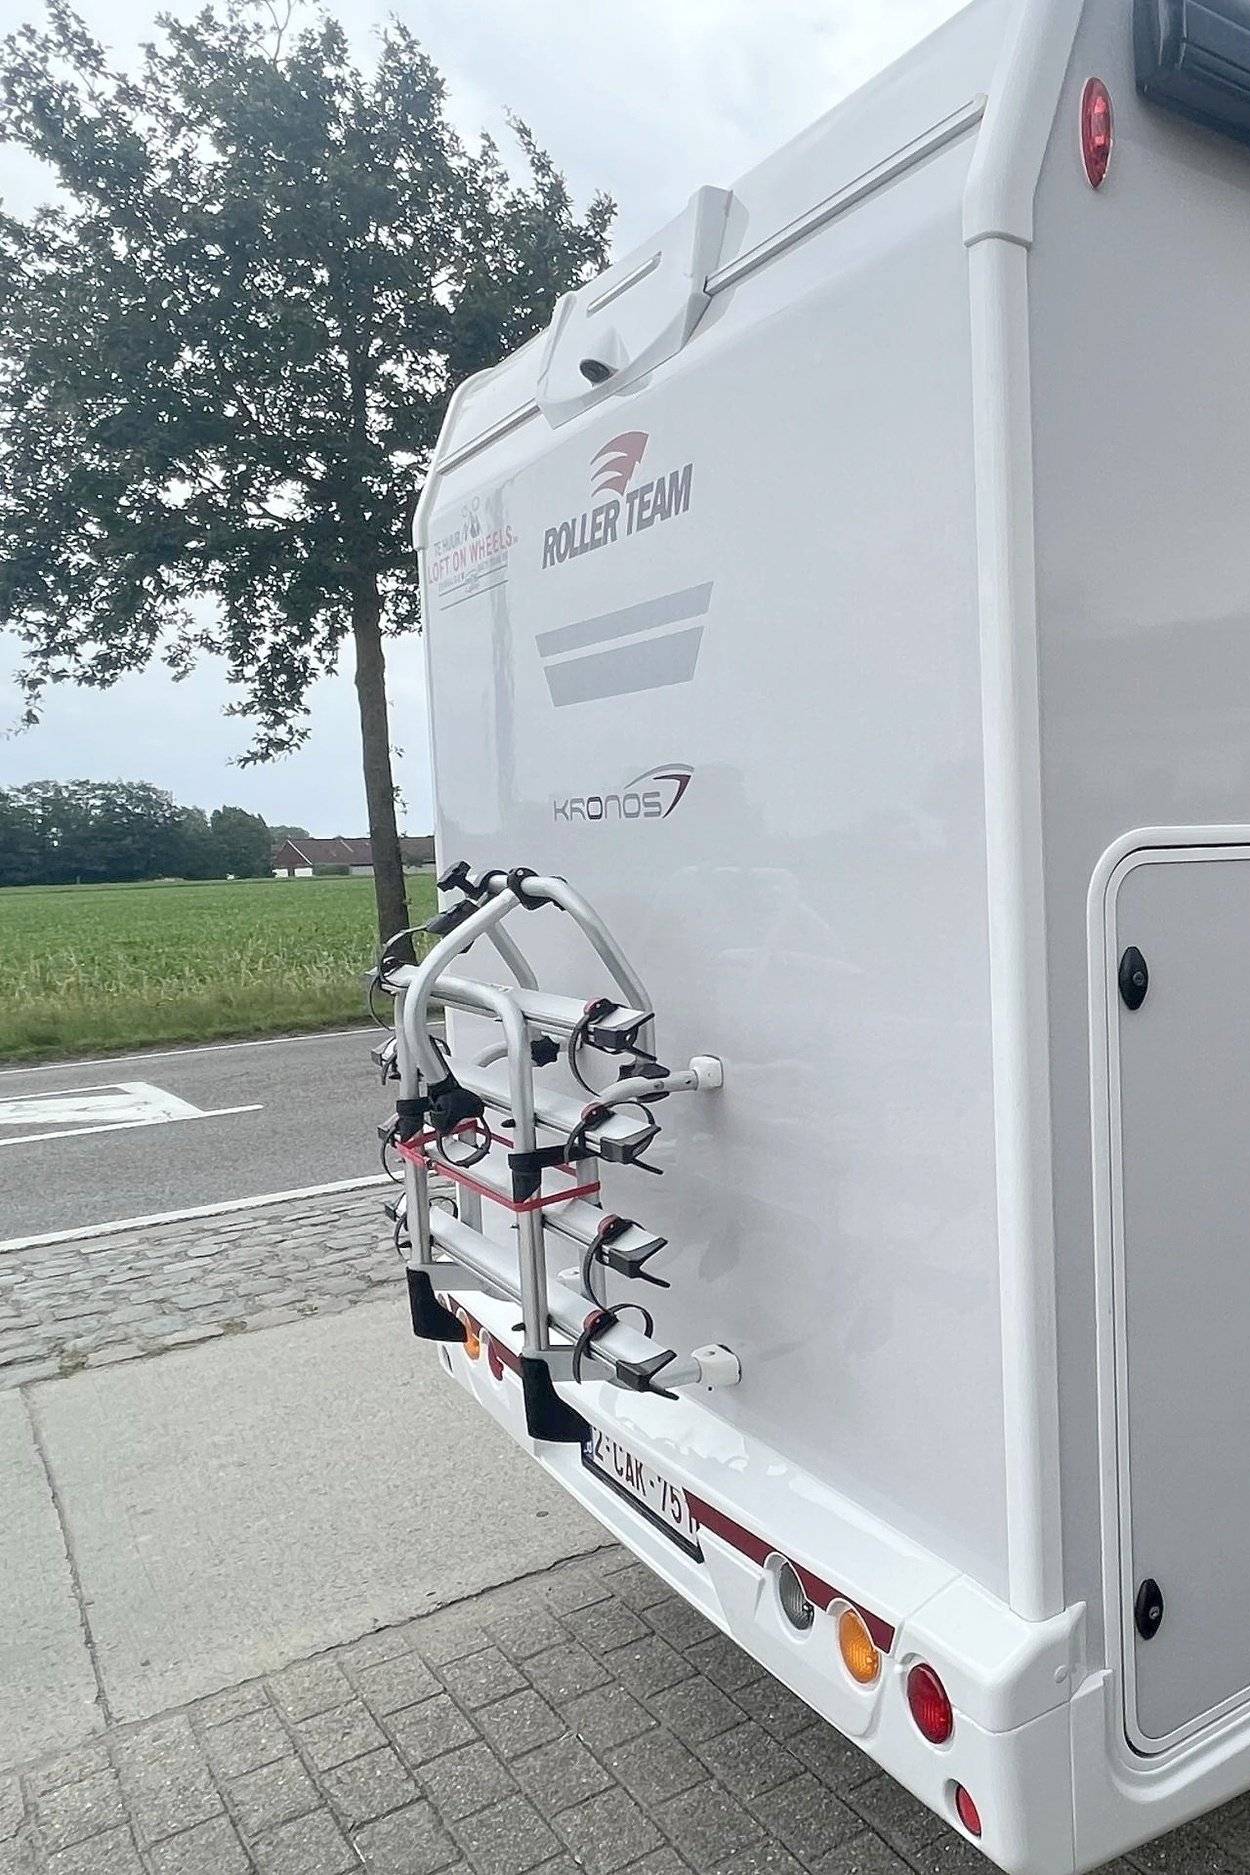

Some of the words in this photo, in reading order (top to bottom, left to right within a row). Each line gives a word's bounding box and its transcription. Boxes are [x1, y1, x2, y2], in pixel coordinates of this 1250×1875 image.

[541, 499, 620, 569] ROLLER
[626, 463, 693, 536] TEAM
[453, 546, 467, 571] ON
[554, 791, 662, 820] KRONOS
